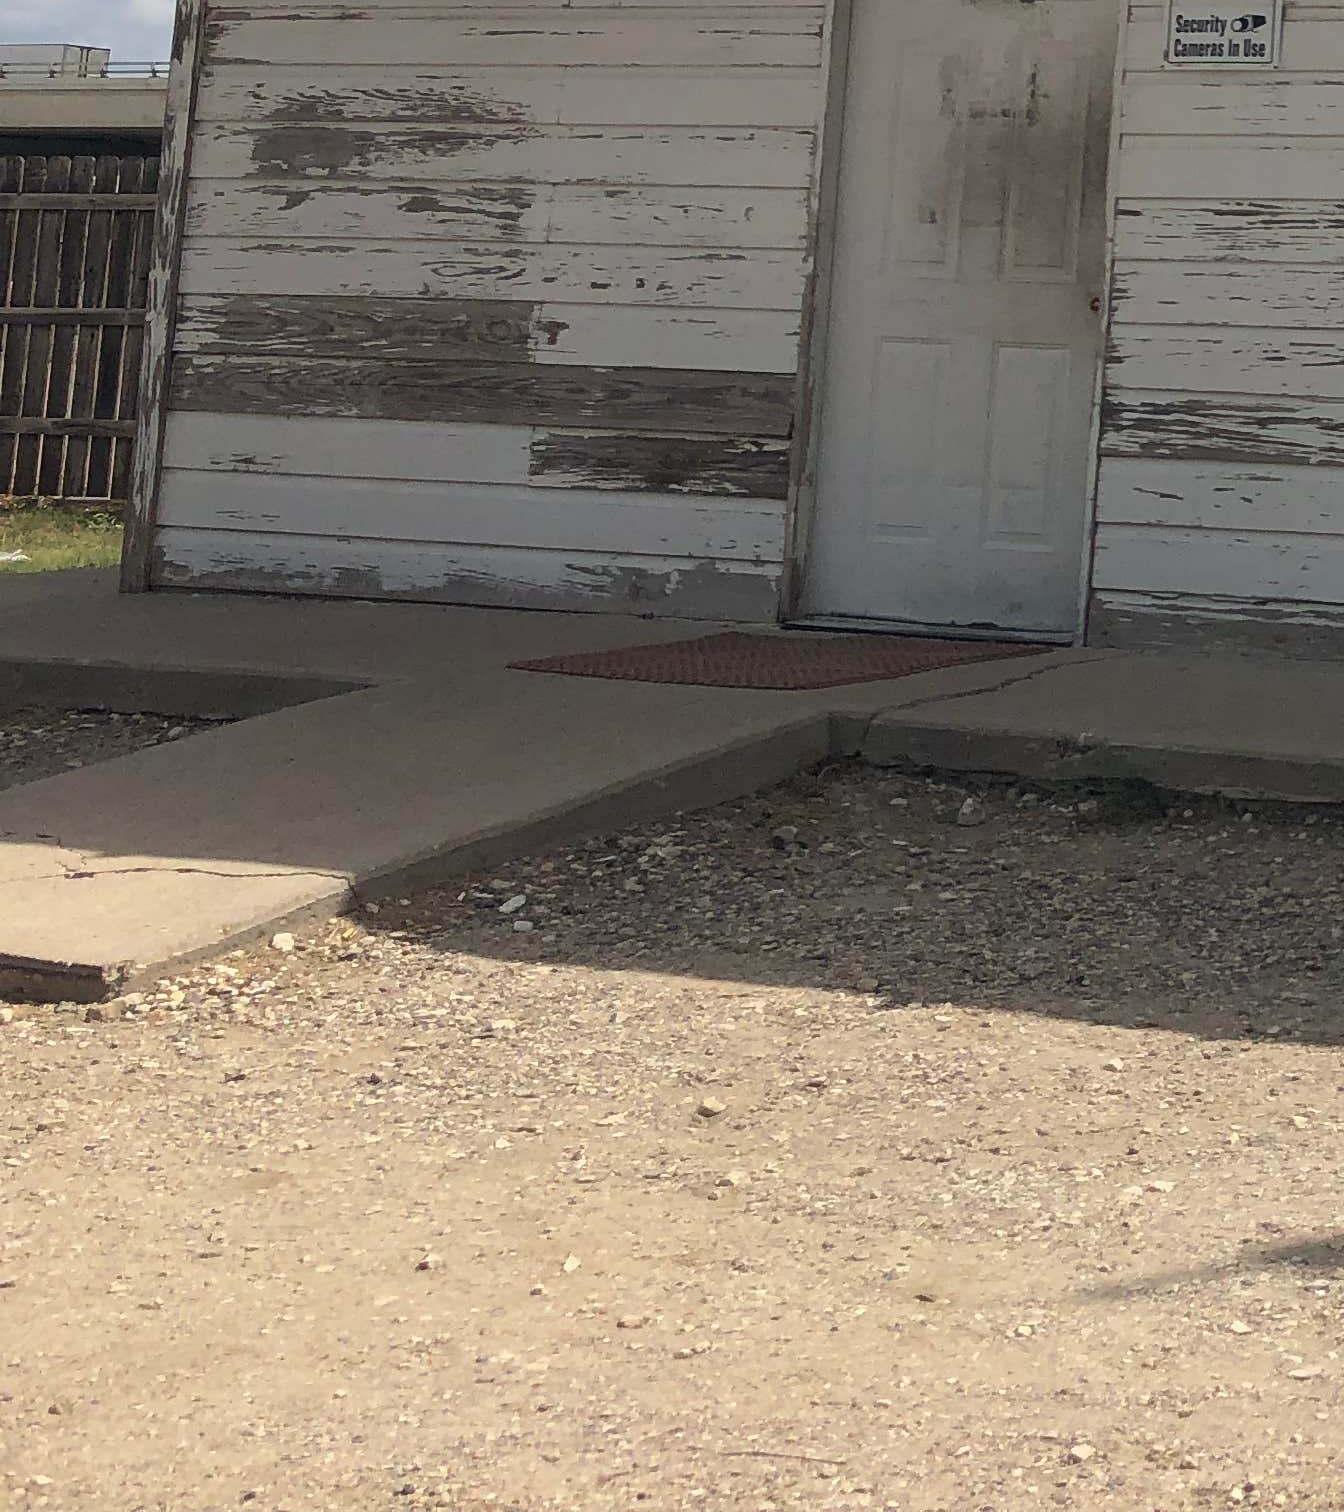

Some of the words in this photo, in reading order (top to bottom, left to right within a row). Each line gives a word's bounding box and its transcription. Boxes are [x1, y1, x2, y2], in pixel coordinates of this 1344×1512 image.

[1175, 14, 1228, 37] Security
[1174, 38, 1225, 57] Cameras
[1228, 38, 1240, 57] In
[1243, 38, 1266, 57] Use
